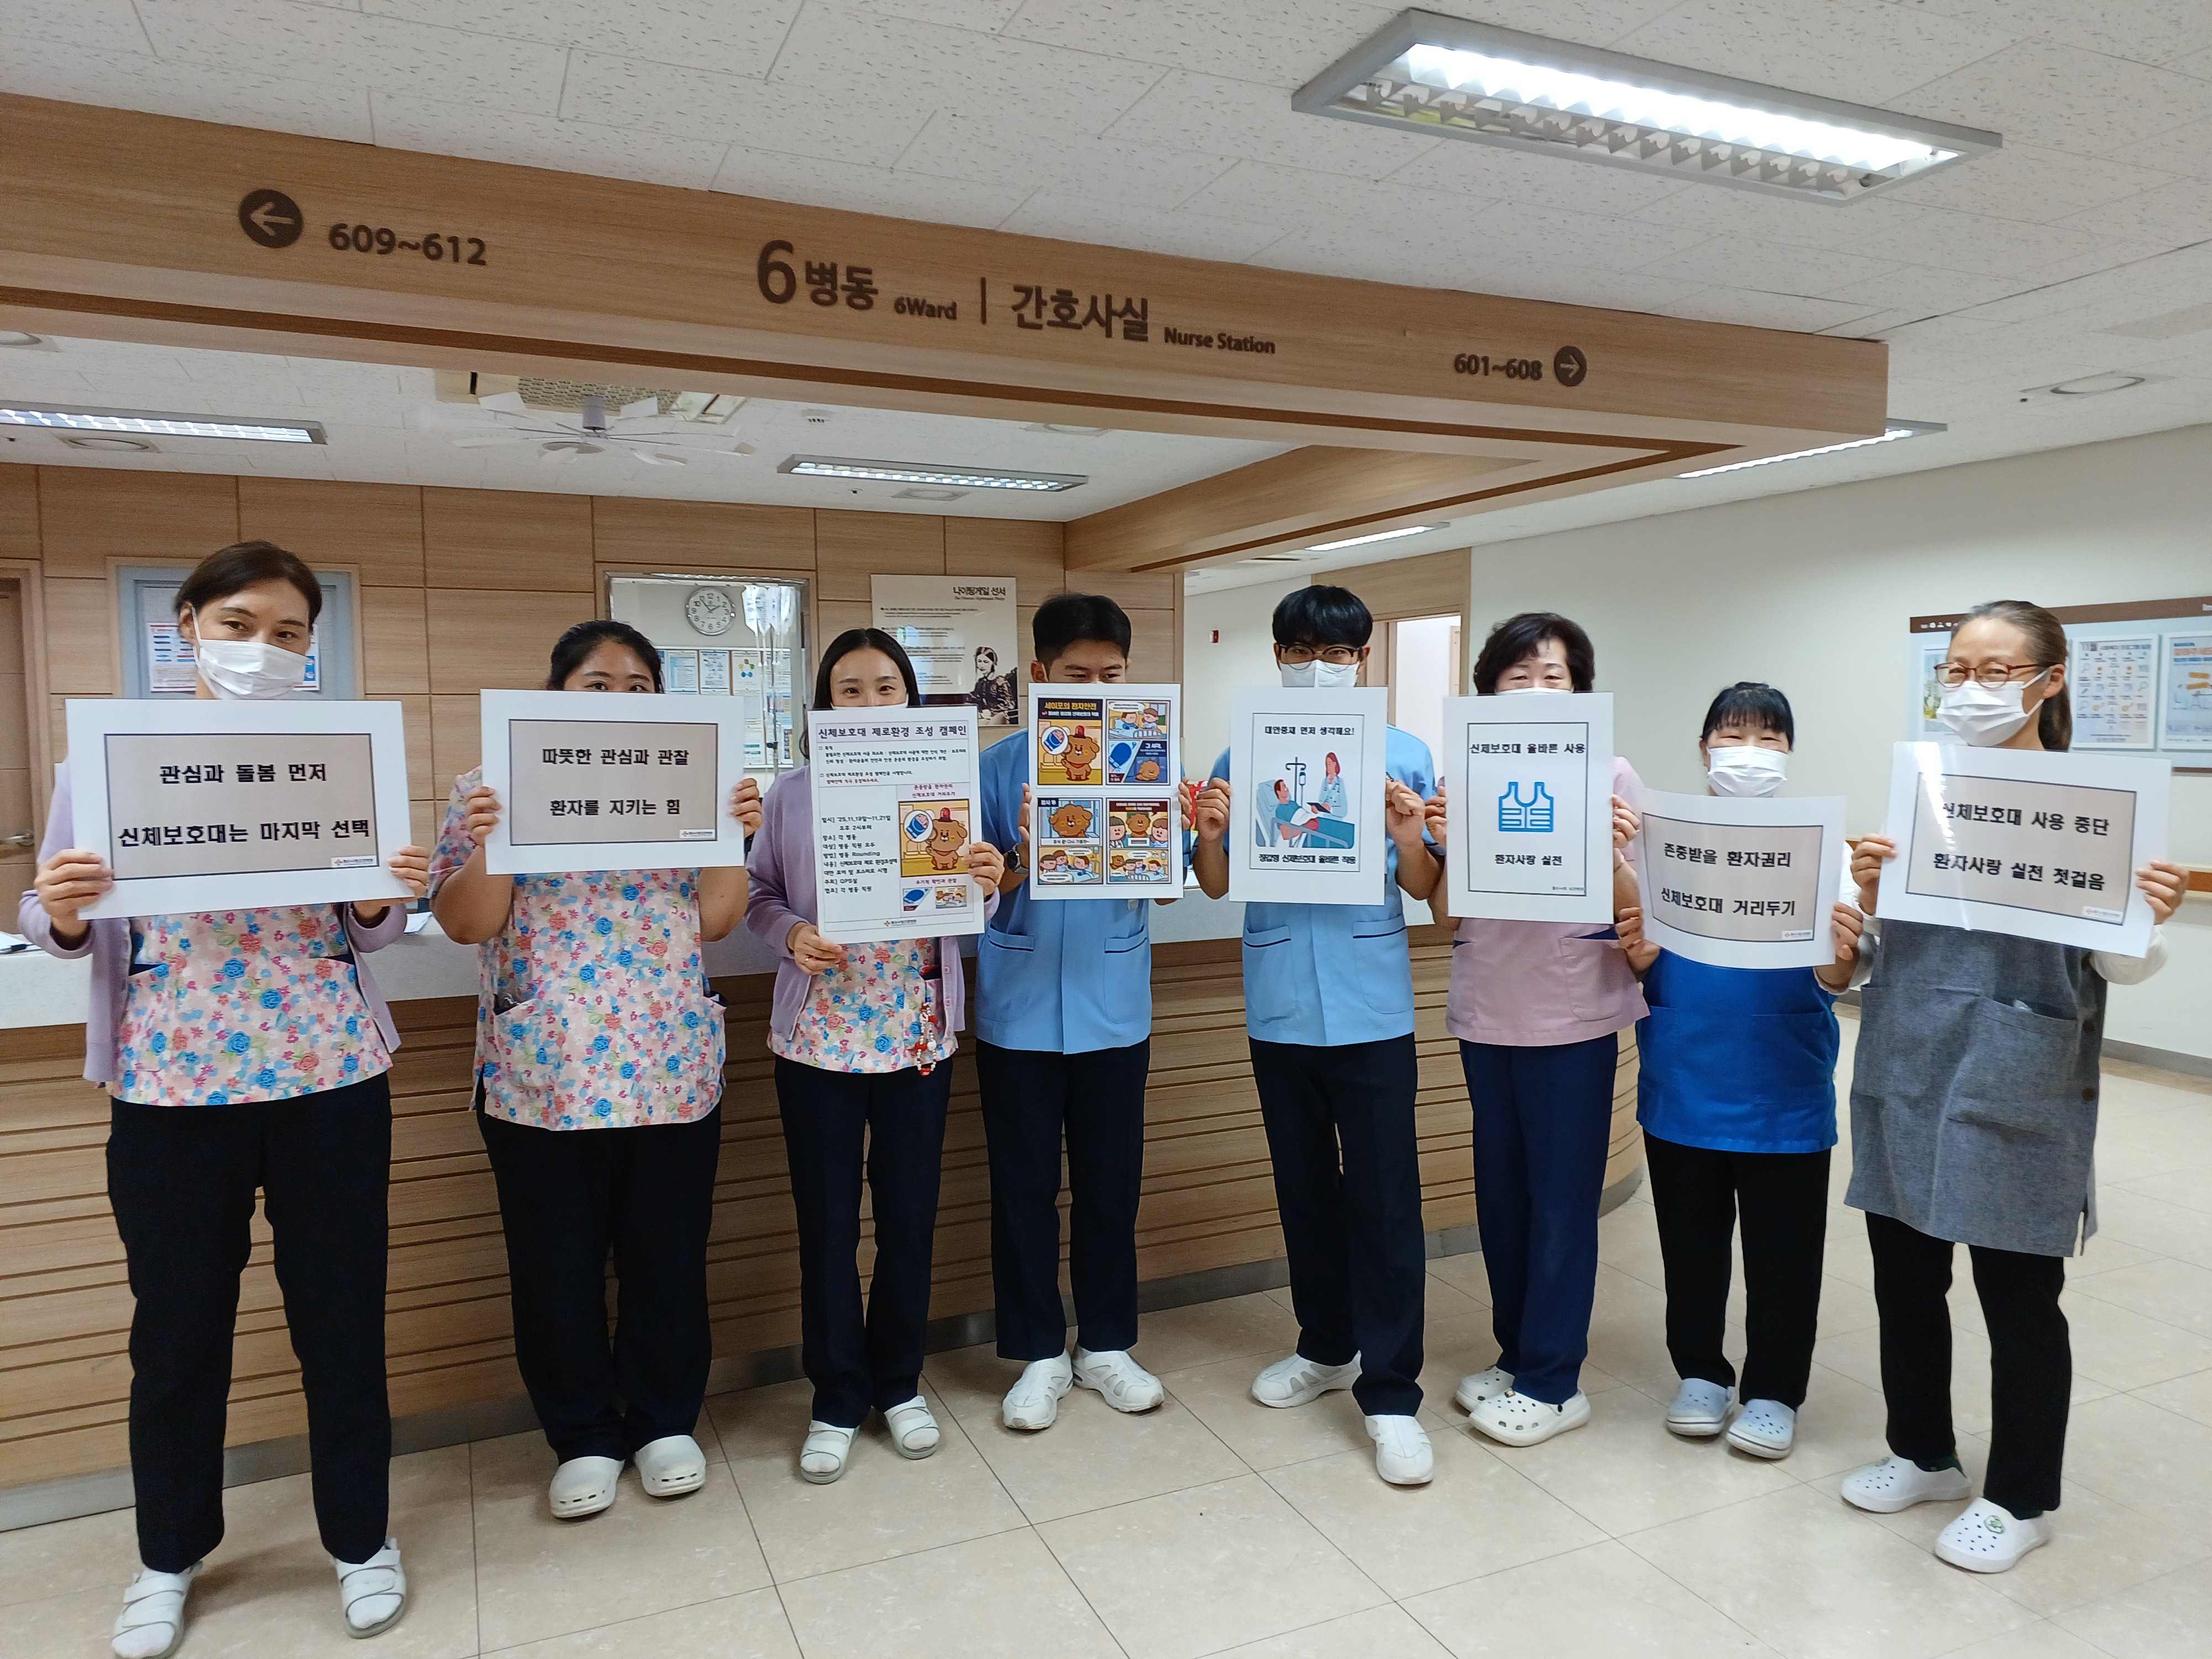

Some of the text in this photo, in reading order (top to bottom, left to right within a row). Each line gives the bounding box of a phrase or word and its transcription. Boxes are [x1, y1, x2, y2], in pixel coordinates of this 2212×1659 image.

[329, 223, 487, 265] 609~612
[894, 296, 957, 321] 6Ward
[1013, 284, 1276, 354] 간호사실 Nurse Station
[1454, 353, 1543, 380] 601~608
[818, 725, 967, 739] 신체보호대 제로환경 조성 캠페인
[1300, 727, 1316, 735] 먼저
[1319, 727, 1354, 735] 생각해요!
[542, 748, 689, 765] 따뜻한 관심과 관찰
[1469, 743, 1586, 754] 신체보호대 올바른 사용
[160, 763, 327, 784] 관심과 돌봄 먼저
[550, 799, 680, 816] 환자를 지키는 힘
[1943, 802, 2109, 836] 신체보호대 사용 중단
[118, 820, 369, 847] 신체보호대는 마지막 선택
[1282, 854, 1316, 863] 신체보호대
[1494, 854, 1562, 866] 환자사랑 실천
[1664, 842, 1791, 868] 존중받을 환자권리
[1933, 853, 2105, 891] 환자사랑 실천 첫걸음
[1661, 888, 1795, 916] 신체보호대 거리두기
